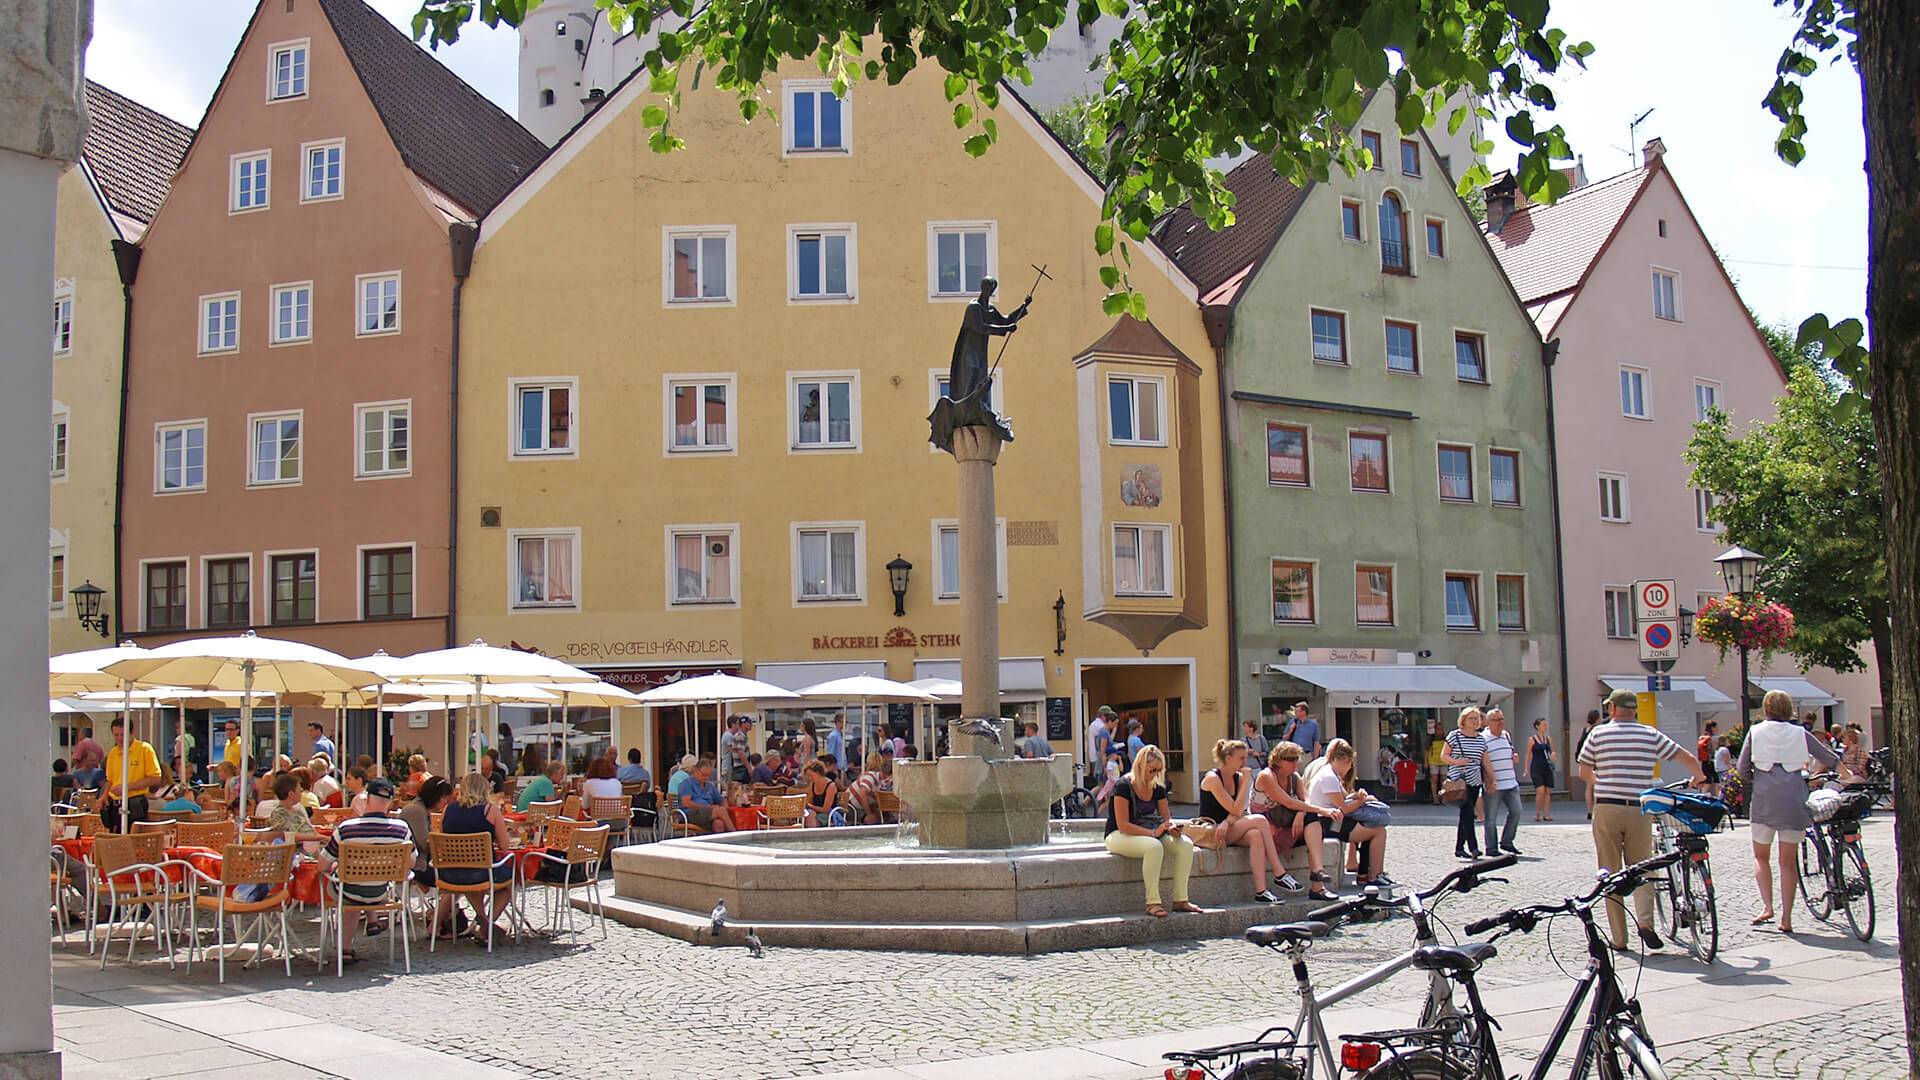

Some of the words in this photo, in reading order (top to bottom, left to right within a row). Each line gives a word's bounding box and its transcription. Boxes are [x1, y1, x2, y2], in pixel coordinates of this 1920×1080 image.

[1649, 590, 1663, 602] 10
[1647, 609, 1668, 617] ZONE
[812, 635, 879, 649] BÄCKEREI
[567, 643, 604, 659] DER
[603, 639, 732, 656] VOGELHÄNDLER
[600, 673, 649, 684] HÄNDLER
